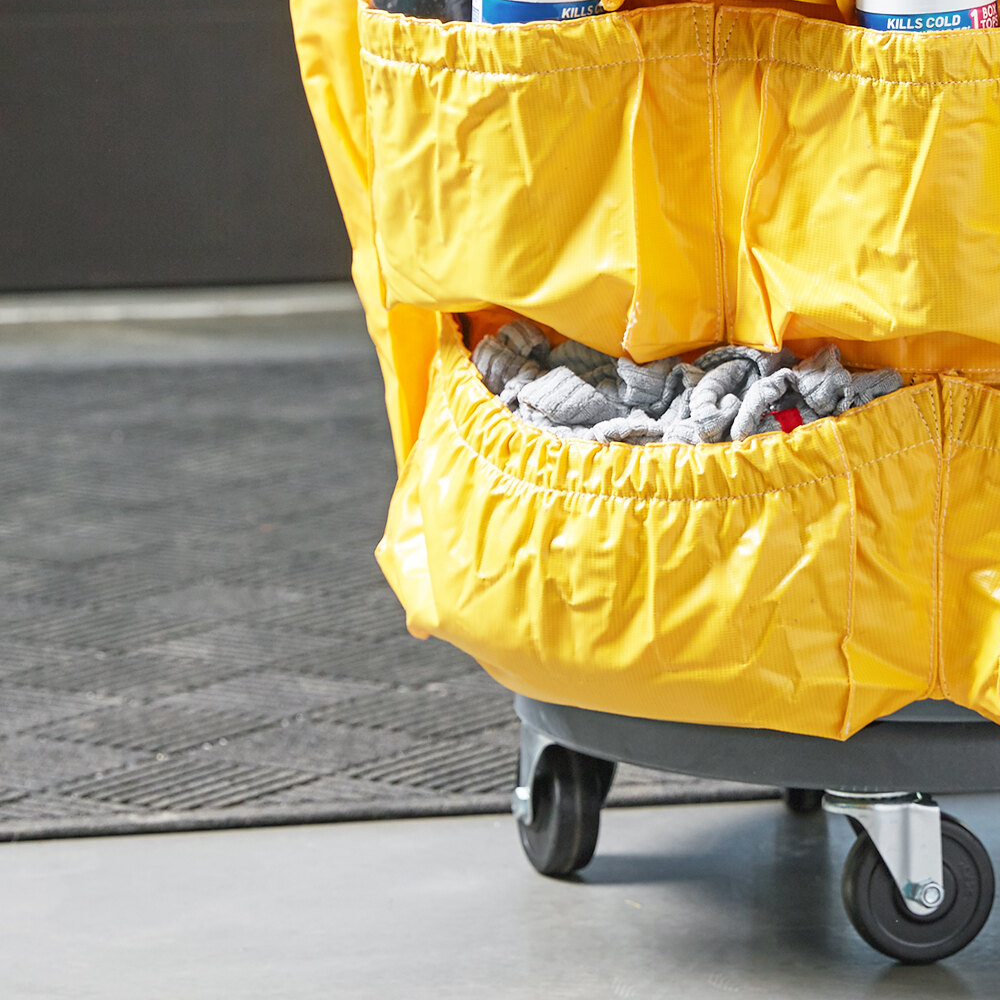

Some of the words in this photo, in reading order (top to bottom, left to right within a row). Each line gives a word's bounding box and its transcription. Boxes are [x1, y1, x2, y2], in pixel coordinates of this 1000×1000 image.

[561, 4, 594, 19] KILLS
[970, 8, 979, 29] 1
[982, 3, 997, 19] BOX
[886, 17, 923, 30] KILLS
[925, 14, 961, 28] COLD
